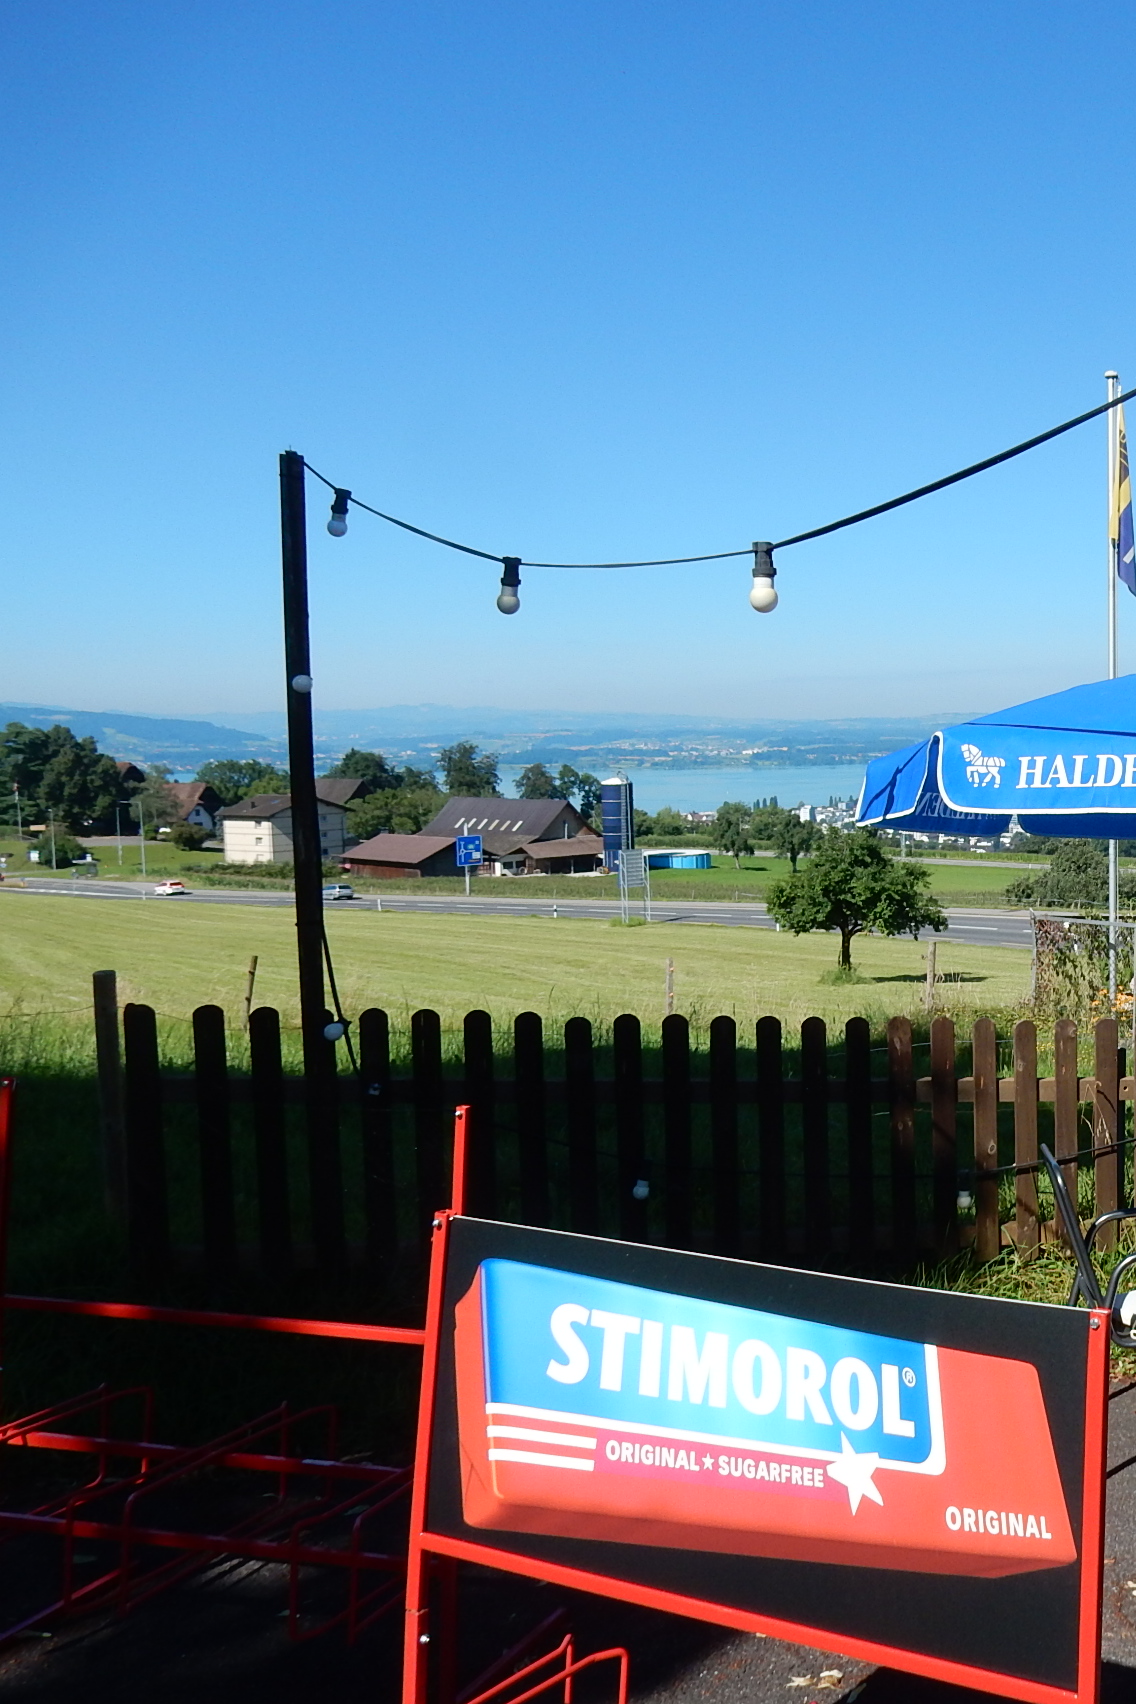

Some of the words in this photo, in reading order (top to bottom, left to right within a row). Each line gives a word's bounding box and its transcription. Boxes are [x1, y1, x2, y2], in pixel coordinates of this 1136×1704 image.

[546, 1303, 916, 1438] STIMOROL
[605, 1439, 700, 1473] ORIGINAL
[717, 1455, 825, 1488] SUGARFREE
[945, 1506, 1053, 1540] ORIGINAL
